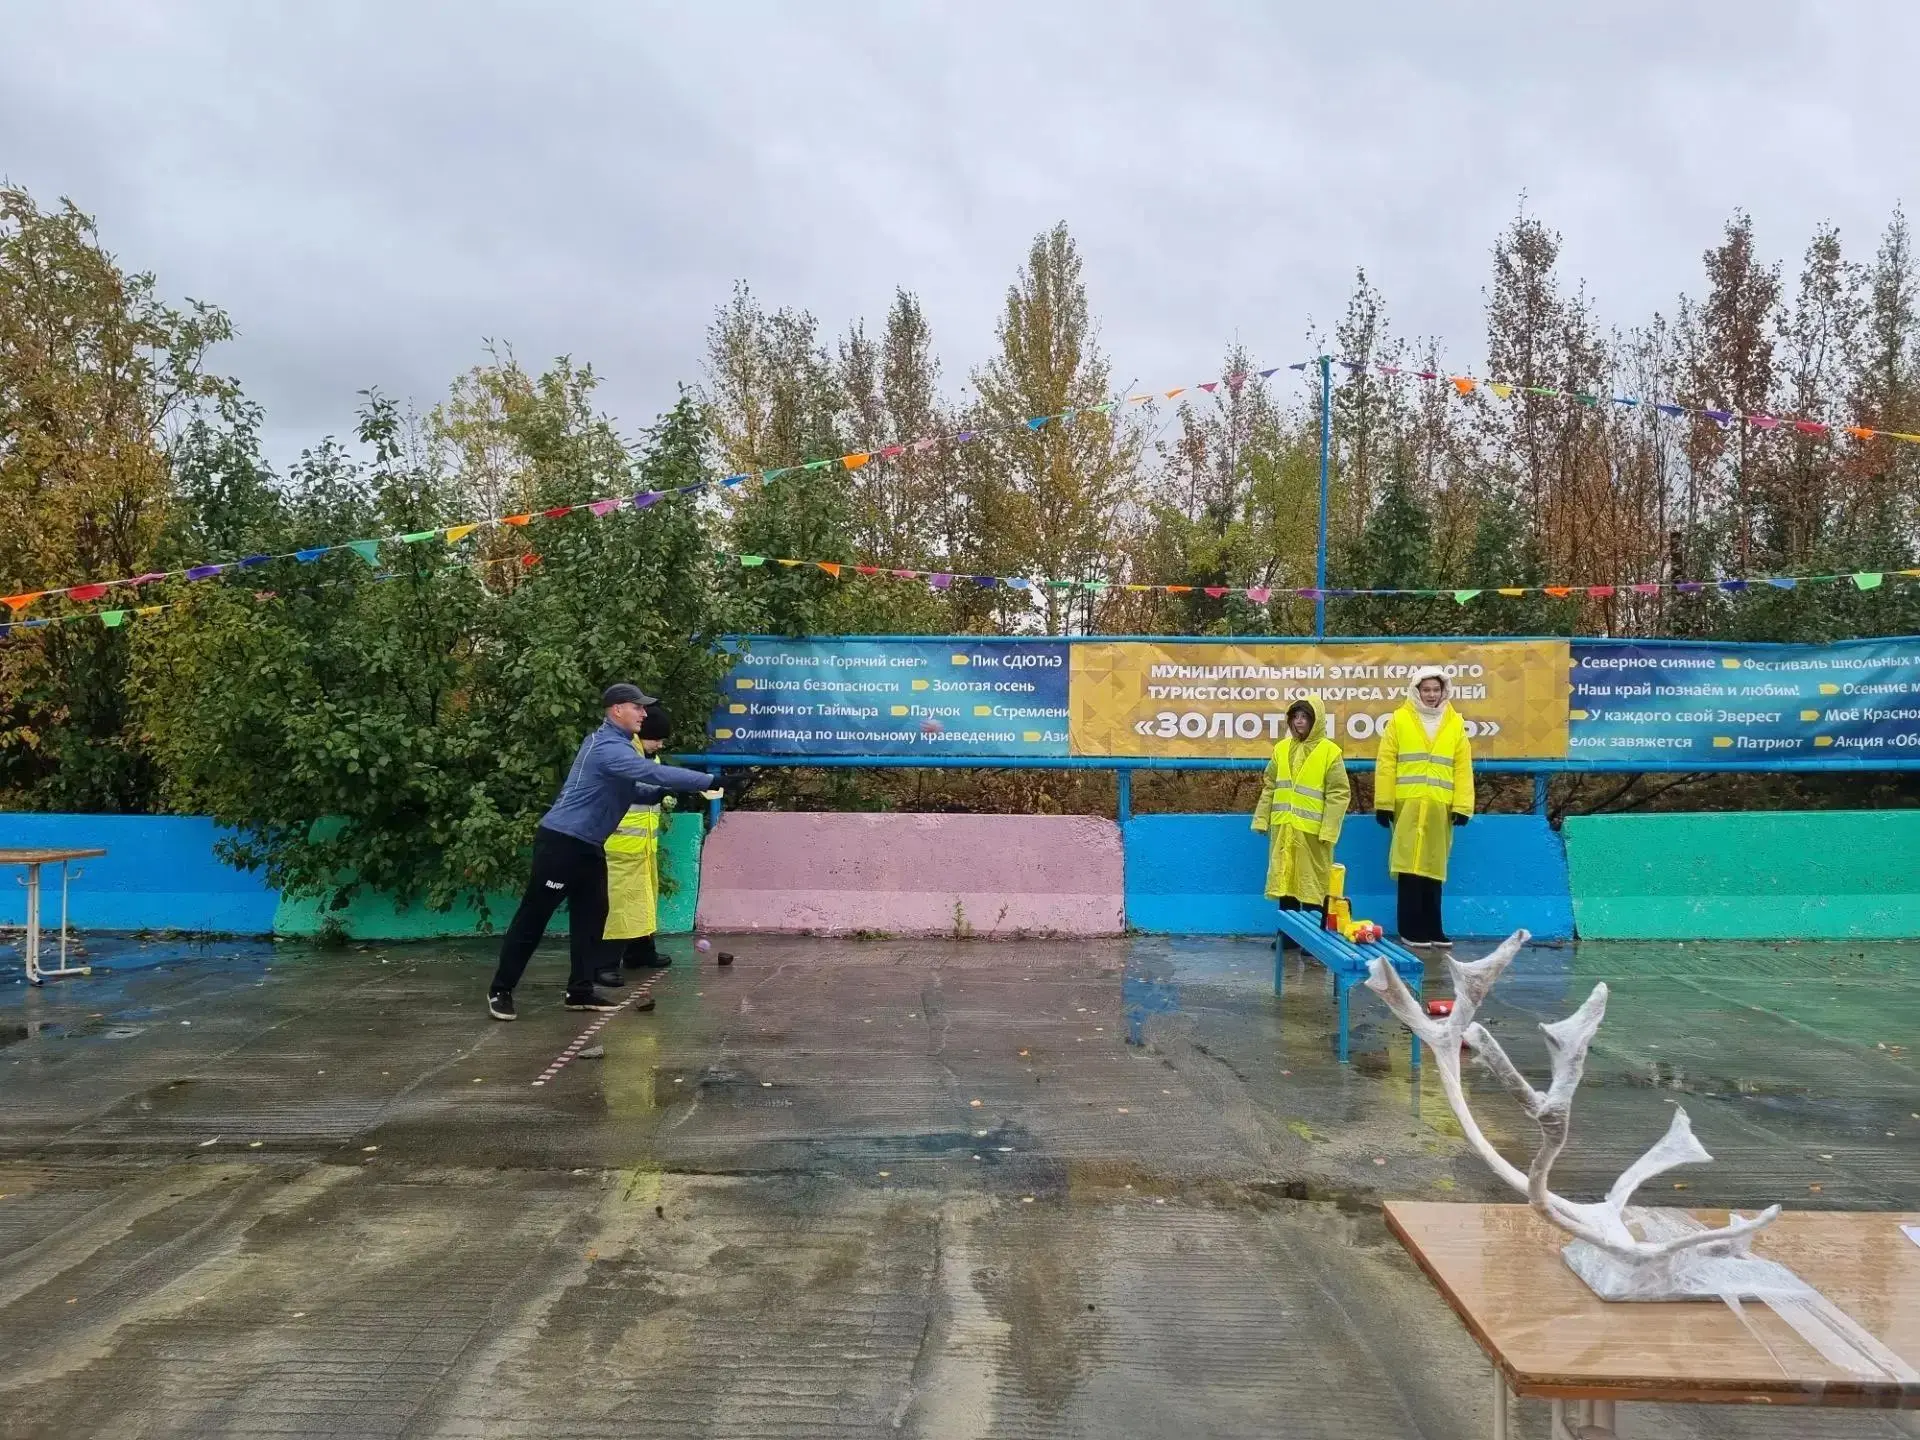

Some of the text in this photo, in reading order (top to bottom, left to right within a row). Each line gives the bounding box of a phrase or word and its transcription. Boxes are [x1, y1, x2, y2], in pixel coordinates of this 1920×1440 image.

[743, 653, 1062, 669] ФотоГонка «Горячий снег» Пик СДЮТиЭ
[1581, 656, 1657, 671] Северное
[1660, 658, 1716, 669] сияние
[1743, 658, 1828, 671] Фестиваль
[1831, 656, 1910, 669] школьных
[1151, 664, 1483, 680] МУНИЦИПАЛЬНЫЙ ЭТАП КРАОГО
[755, 678, 1035, 692] Школа безопасности Золотая осень
[1148, 685, 1279, 700] ТУРИСТСКОГО
[1387, 683, 1486, 700] УЧЛЕЙ
[1578, 683, 1611, 696] Наш
[1615, 683, 1651, 698] край
[1655, 683, 1724, 696] познаём
[1727, 687, 1737, 696] и
[1740, 683, 1800, 696] любим!
[1842, 683, 1908, 695] Осенние
[750, 703, 794, 715] Ключи
[797, 706, 813, 715] от
[816, 704, 879, 719] Таймыра
[910, 705, 961, 720] Паучок
[1590, 709, 1601, 721] У
[1604, 712, 1671, 724] каждого
[1675, 709, 1713, 722] свой
[1716, 710, 1781, 725] Эверест
[1824, 708, 1859, 721] Моё
[1134, 712, 1335, 739] «ЗОЛОТ
[735, 728, 812, 742] Олимпиада
[815, 731, 833, 740] по
[836, 731, 917, 743] школьному
[920, 731, 1015, 744] краеведению
[1609, 736, 1693, 748] завяжется
[1737, 736, 1804, 751] Патриот
[1834, 735, 1884, 750] Акция
